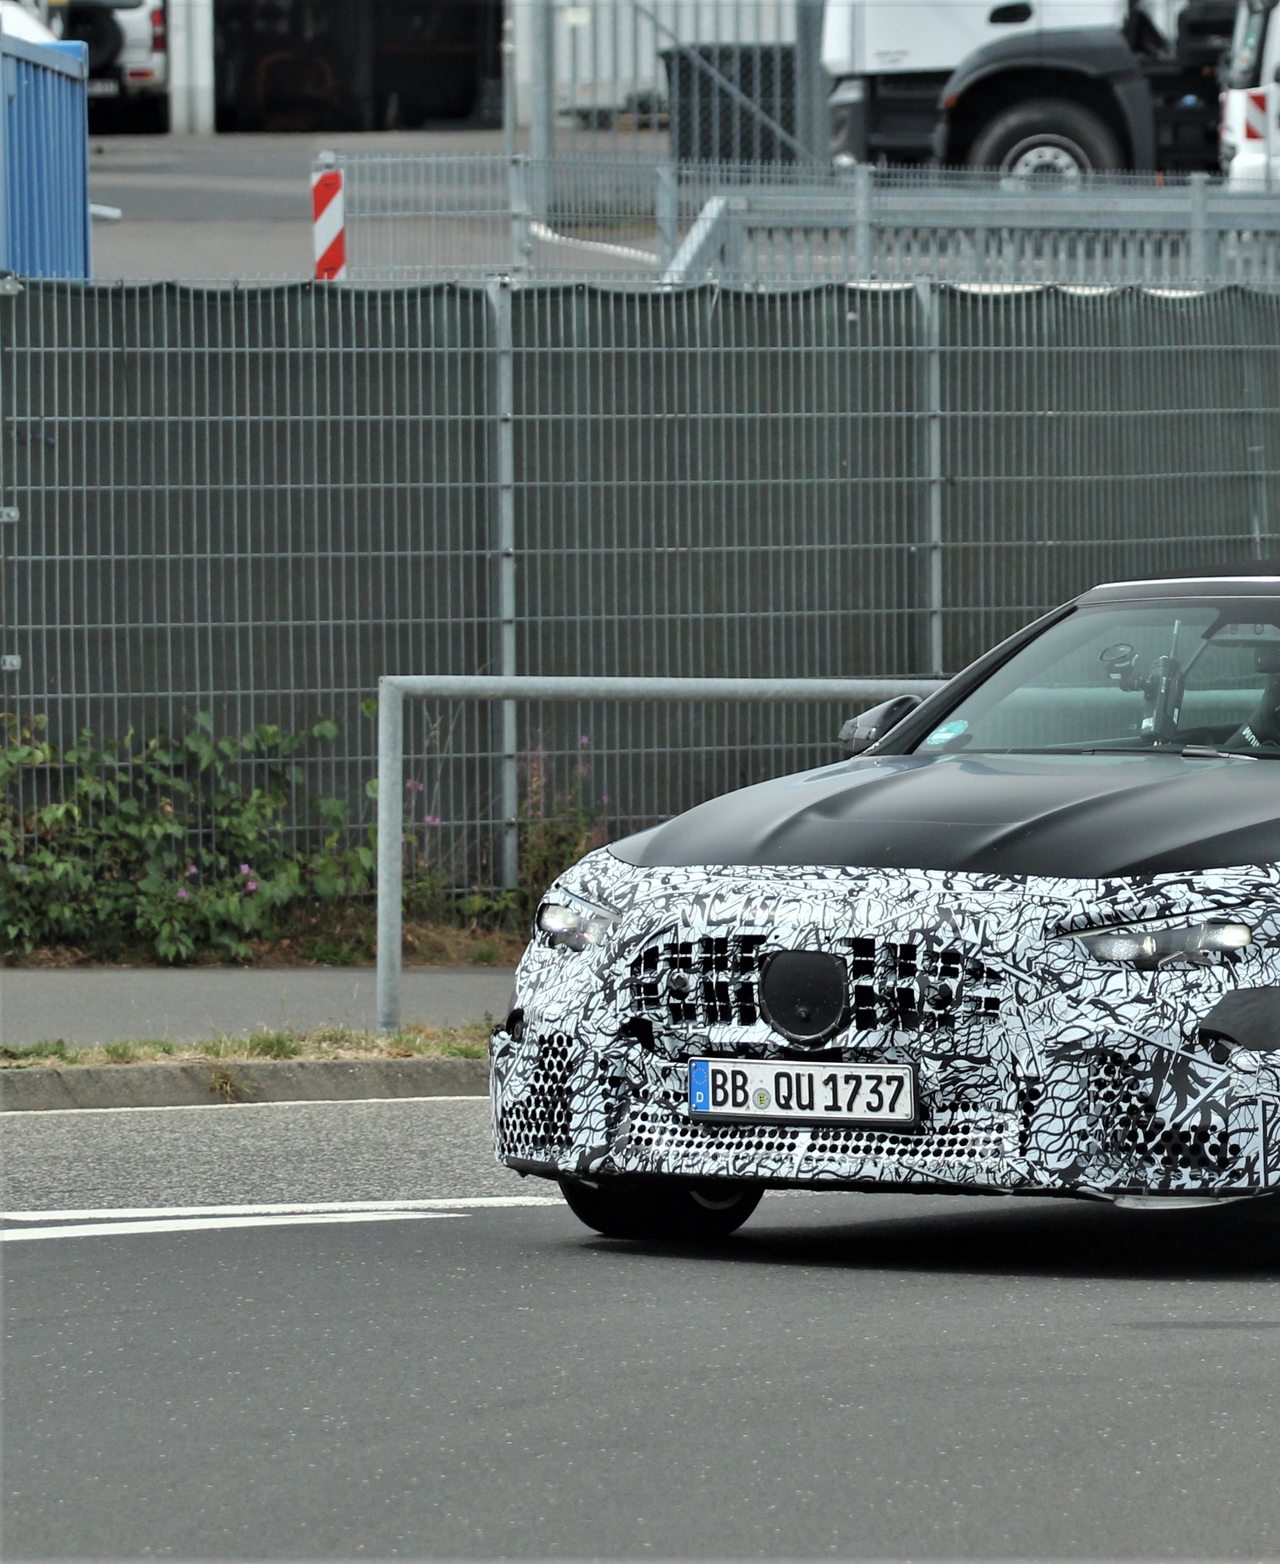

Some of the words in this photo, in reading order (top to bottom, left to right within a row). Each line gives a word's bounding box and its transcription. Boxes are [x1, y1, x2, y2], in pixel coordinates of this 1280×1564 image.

[696, 1091, 704, 1103] D
[711, 1068, 749, 1108] BB
[774, 1071, 814, 1111] QU
[822, 1073, 904, 1113] 1737
